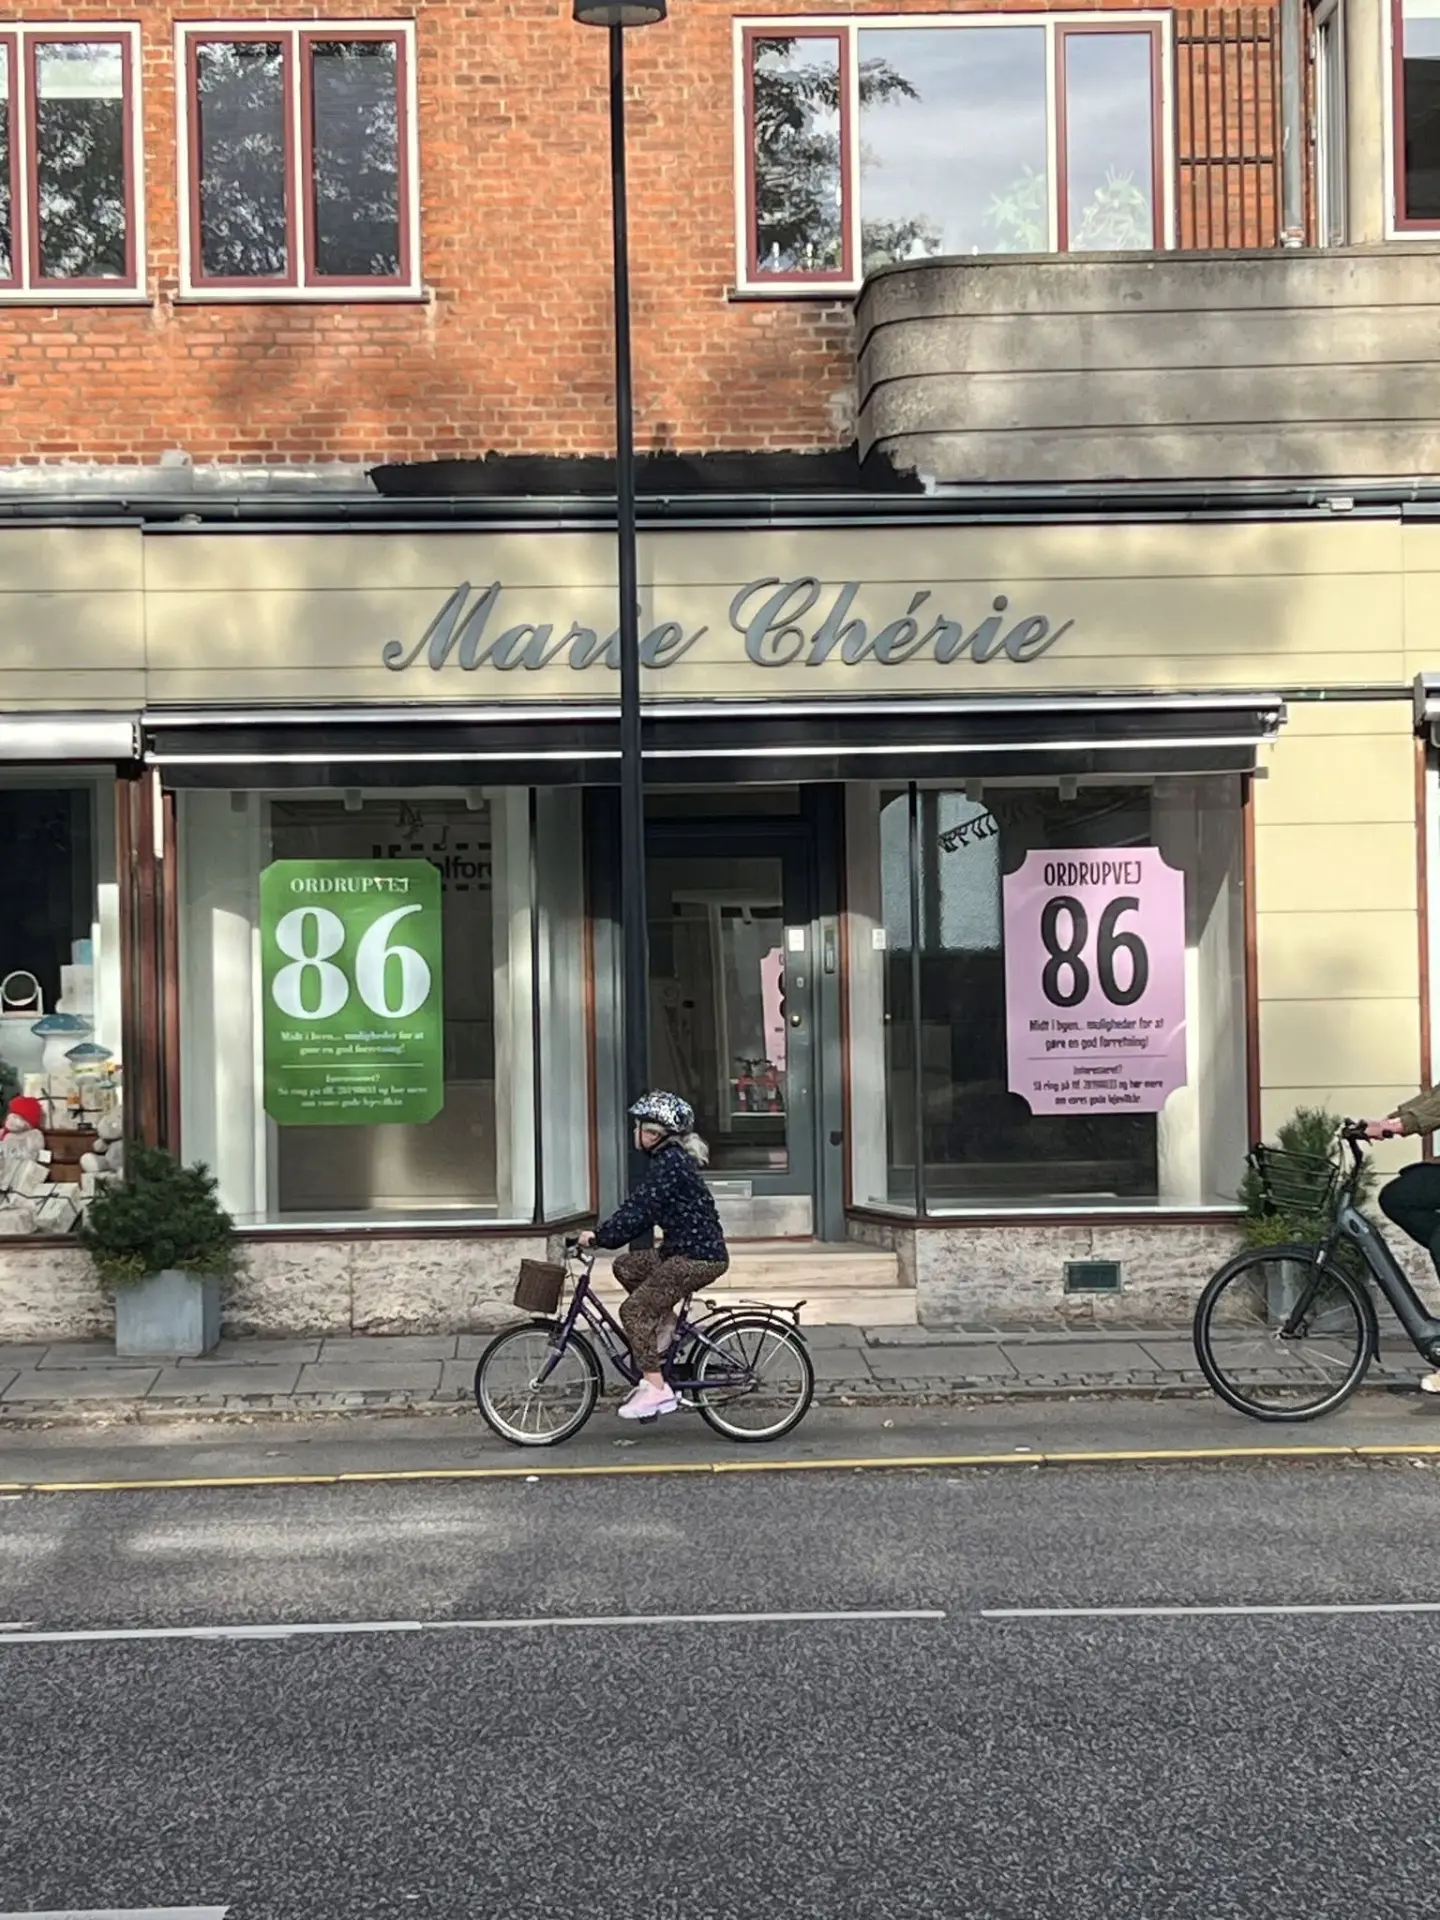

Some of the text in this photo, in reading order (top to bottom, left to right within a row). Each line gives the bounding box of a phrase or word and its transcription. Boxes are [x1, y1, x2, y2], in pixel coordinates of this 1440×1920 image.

[729, 575, 1076, 667] Chérie
[290, 876, 409, 894] ORDRUPVEJ
[1043, 861, 1142, 887] ORDRUPVEJ
[271, 903, 432, 1019] 86
[1040, 895, 1149, 1007] 86
[1081, 1037, 1097, 1050] god
